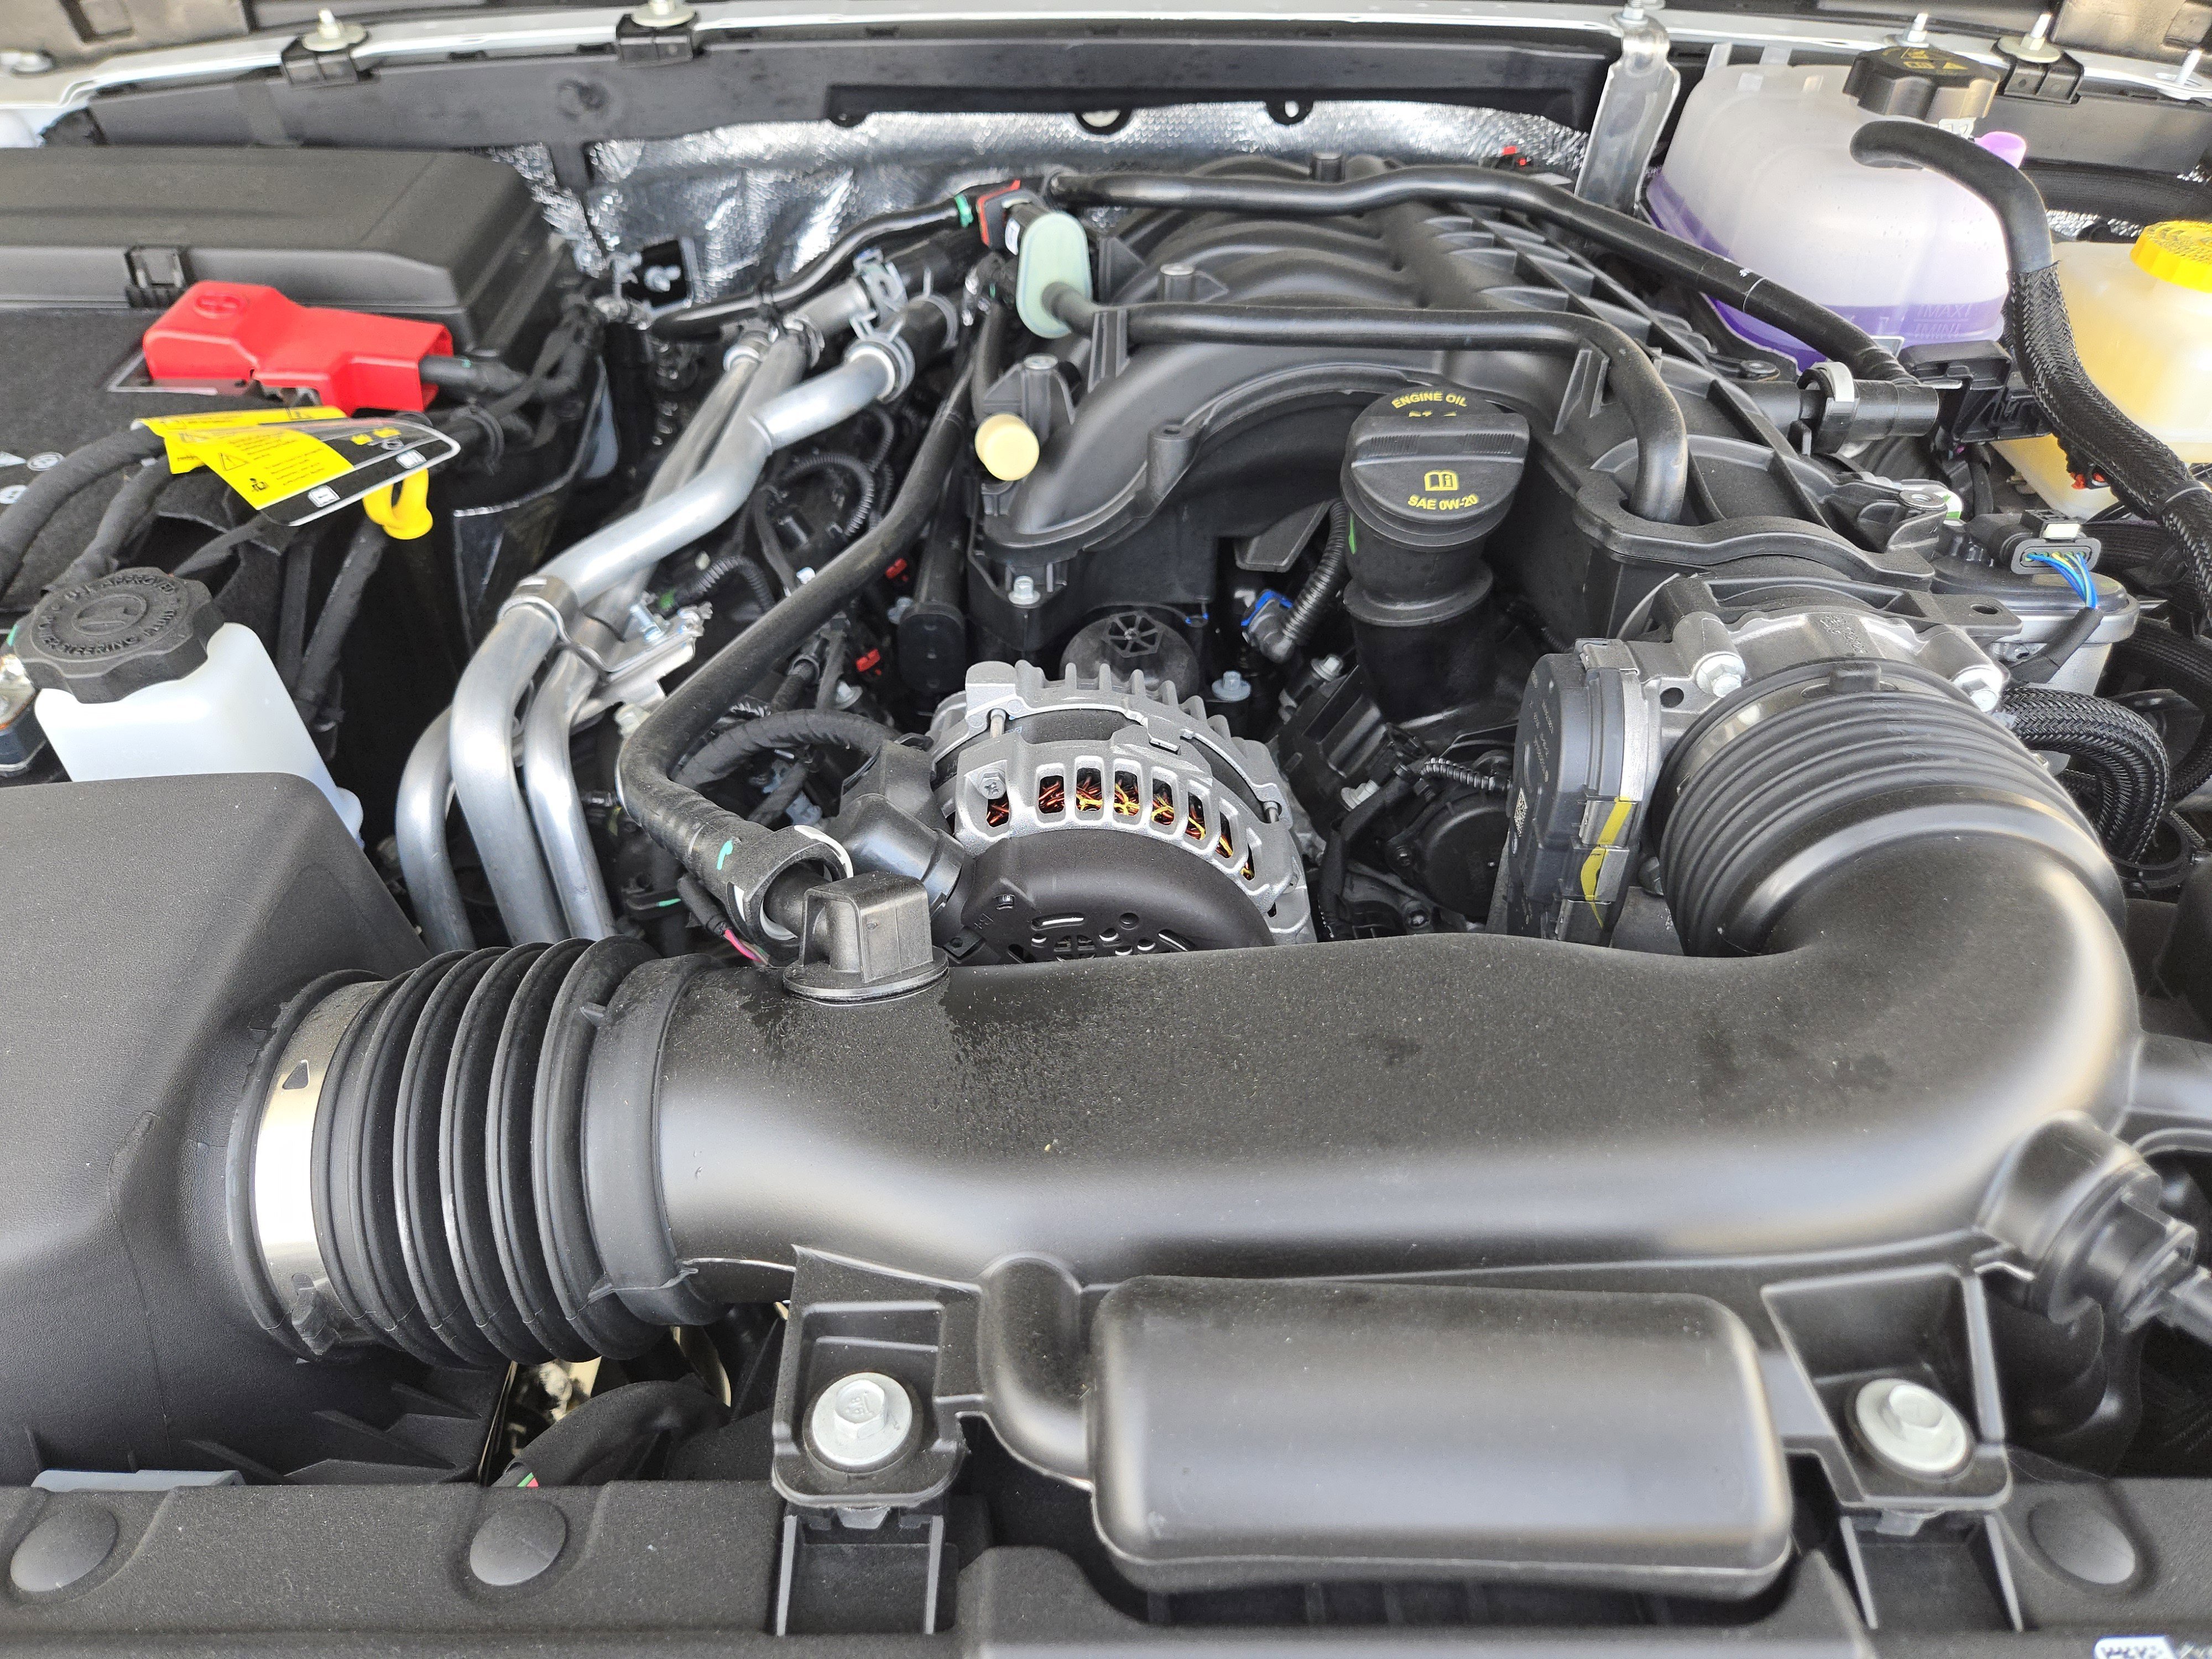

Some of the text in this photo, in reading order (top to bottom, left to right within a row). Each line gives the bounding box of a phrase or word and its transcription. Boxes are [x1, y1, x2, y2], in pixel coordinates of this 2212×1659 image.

[1391, 392, 1467, 409] ENGINE OIL
[1407, 494, 1479, 510] SAE 0W-20
